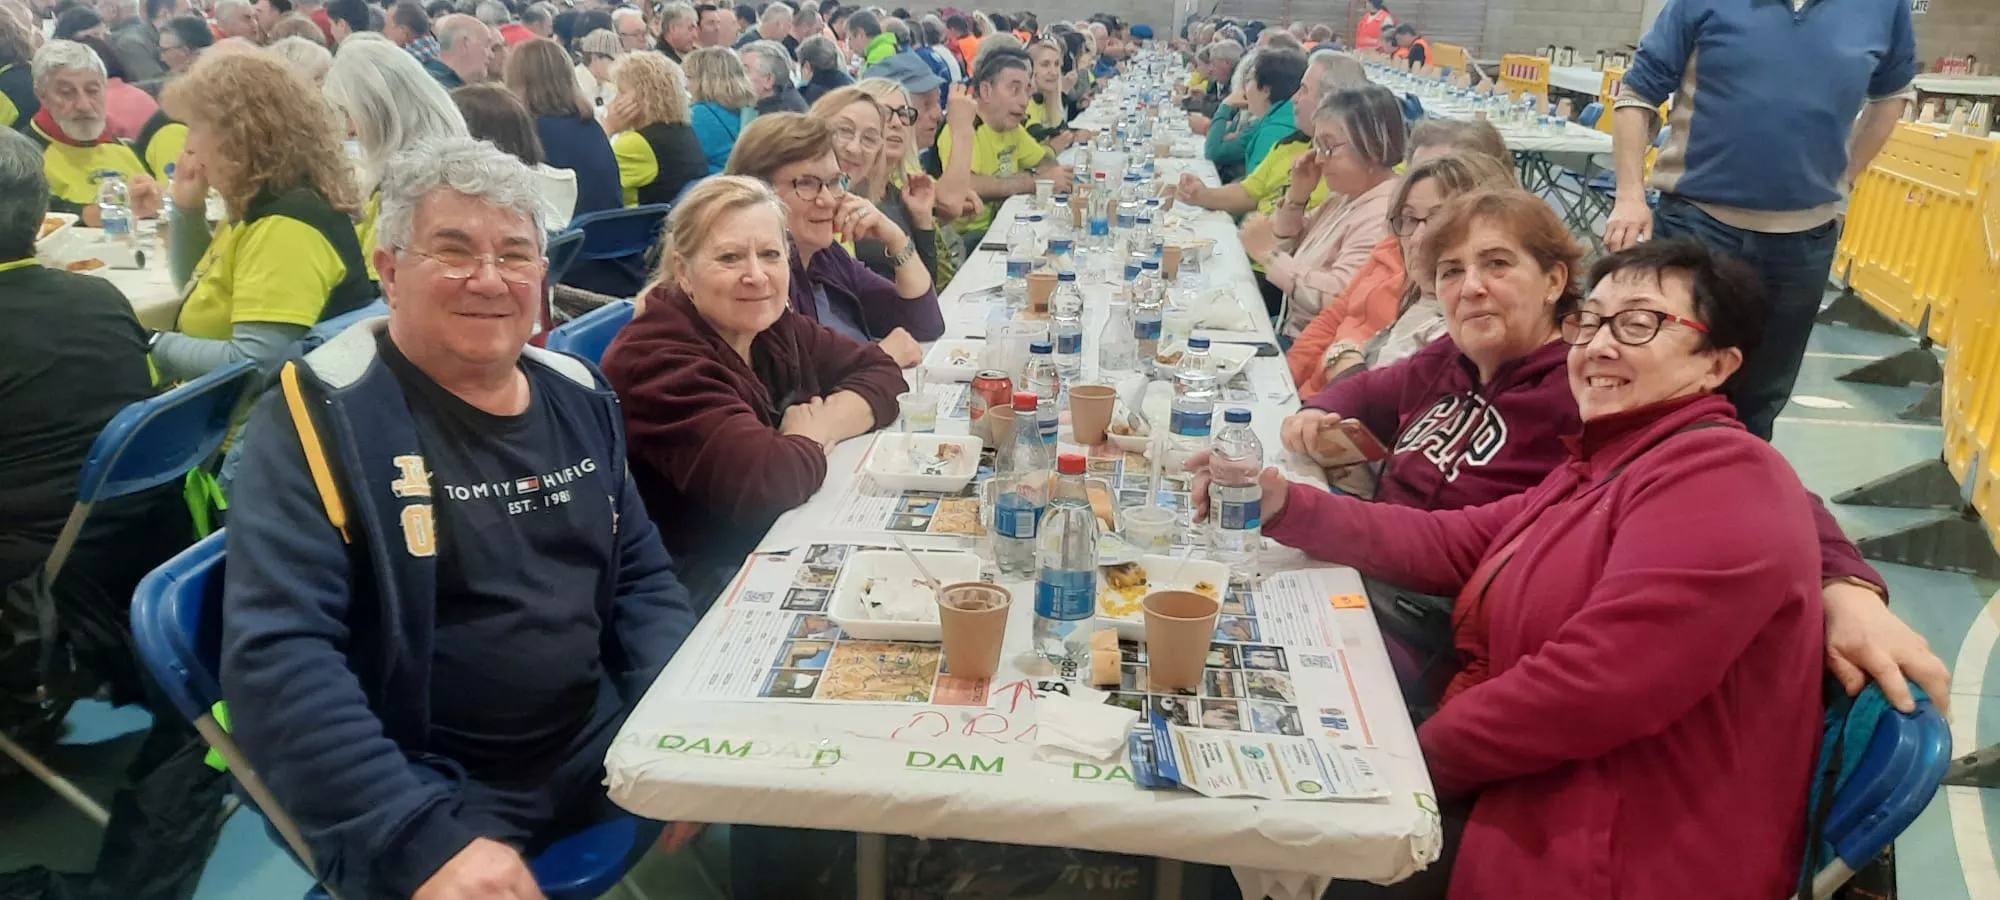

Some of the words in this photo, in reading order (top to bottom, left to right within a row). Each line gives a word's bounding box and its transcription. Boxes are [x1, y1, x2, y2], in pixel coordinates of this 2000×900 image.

[507, 499, 538, 515] EST.
[657, 734, 753, 758] DAM
[905, 751, 1004, 772] DAM
[1072, 763, 1136, 783] DA
